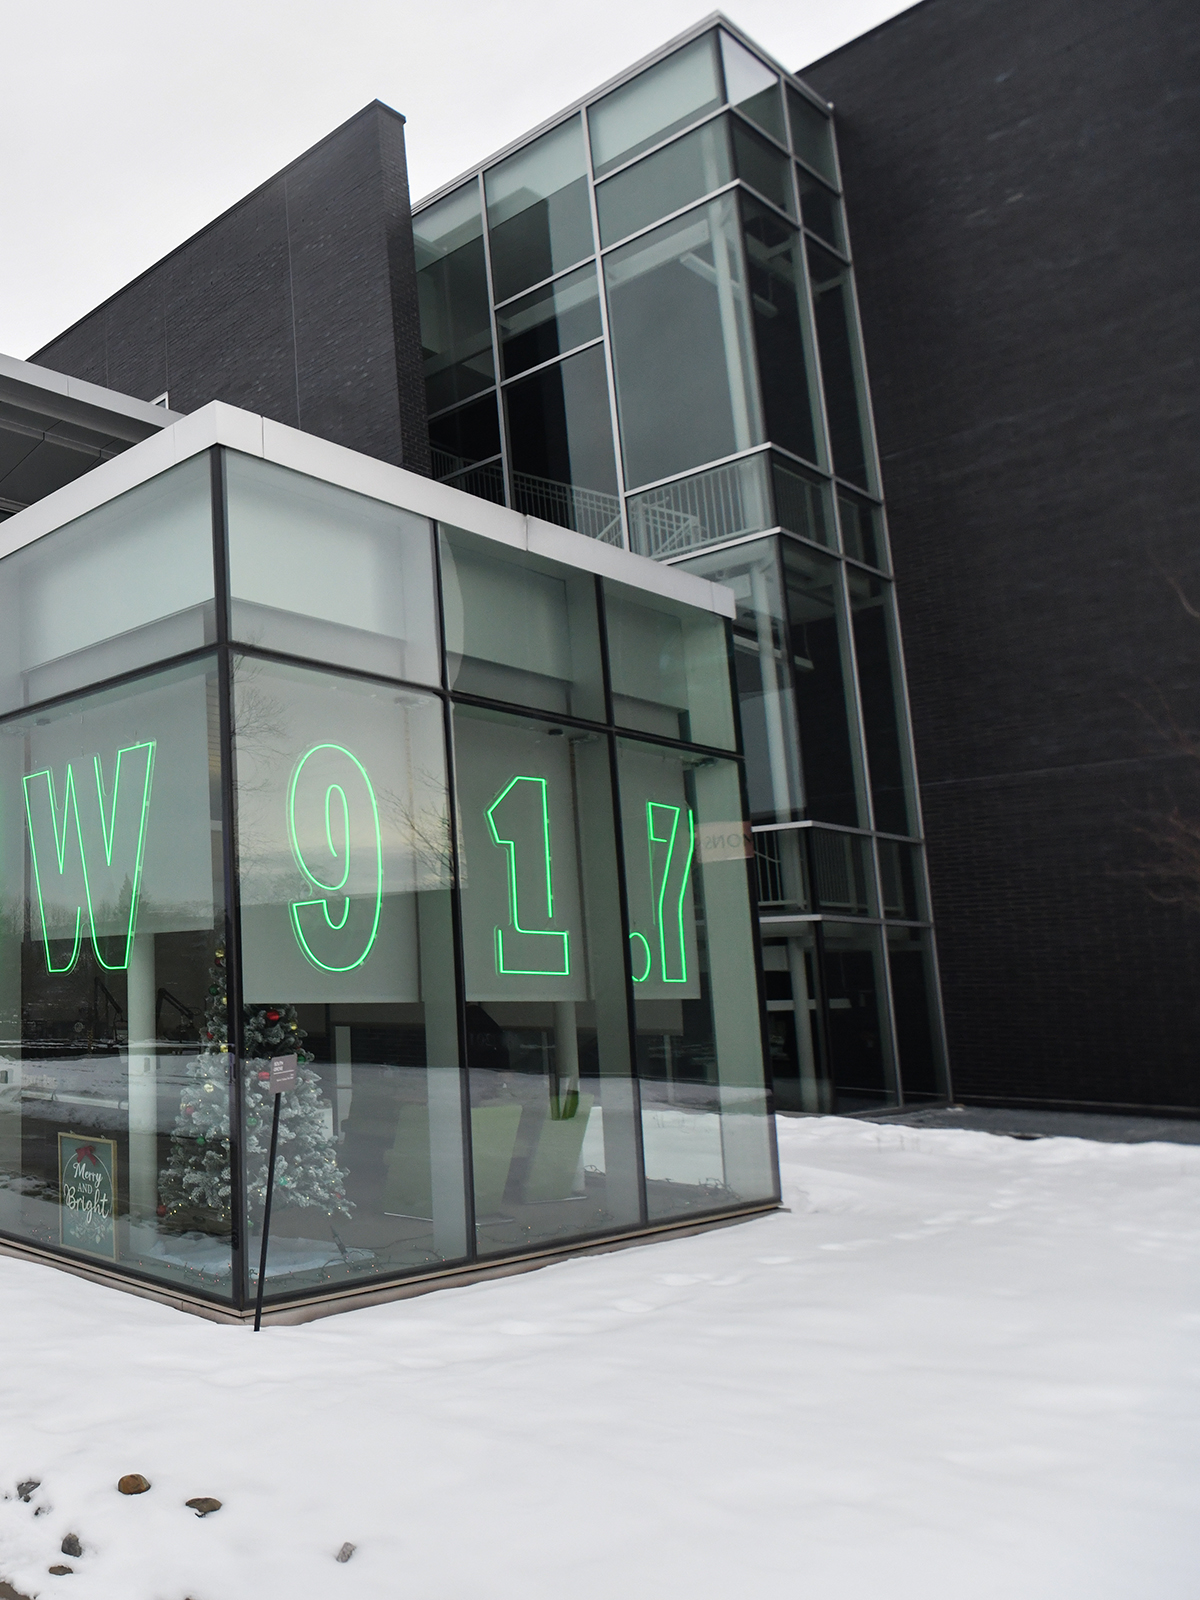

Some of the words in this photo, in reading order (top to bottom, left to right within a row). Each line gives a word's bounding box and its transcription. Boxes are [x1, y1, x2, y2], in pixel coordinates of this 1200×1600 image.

[288, 743, 695, 983] 91.7
[73, 1162, 103, 1188] Merry
[77, 1184, 93, 1195] AND
[64, 1184, 109, 1224] Bright
